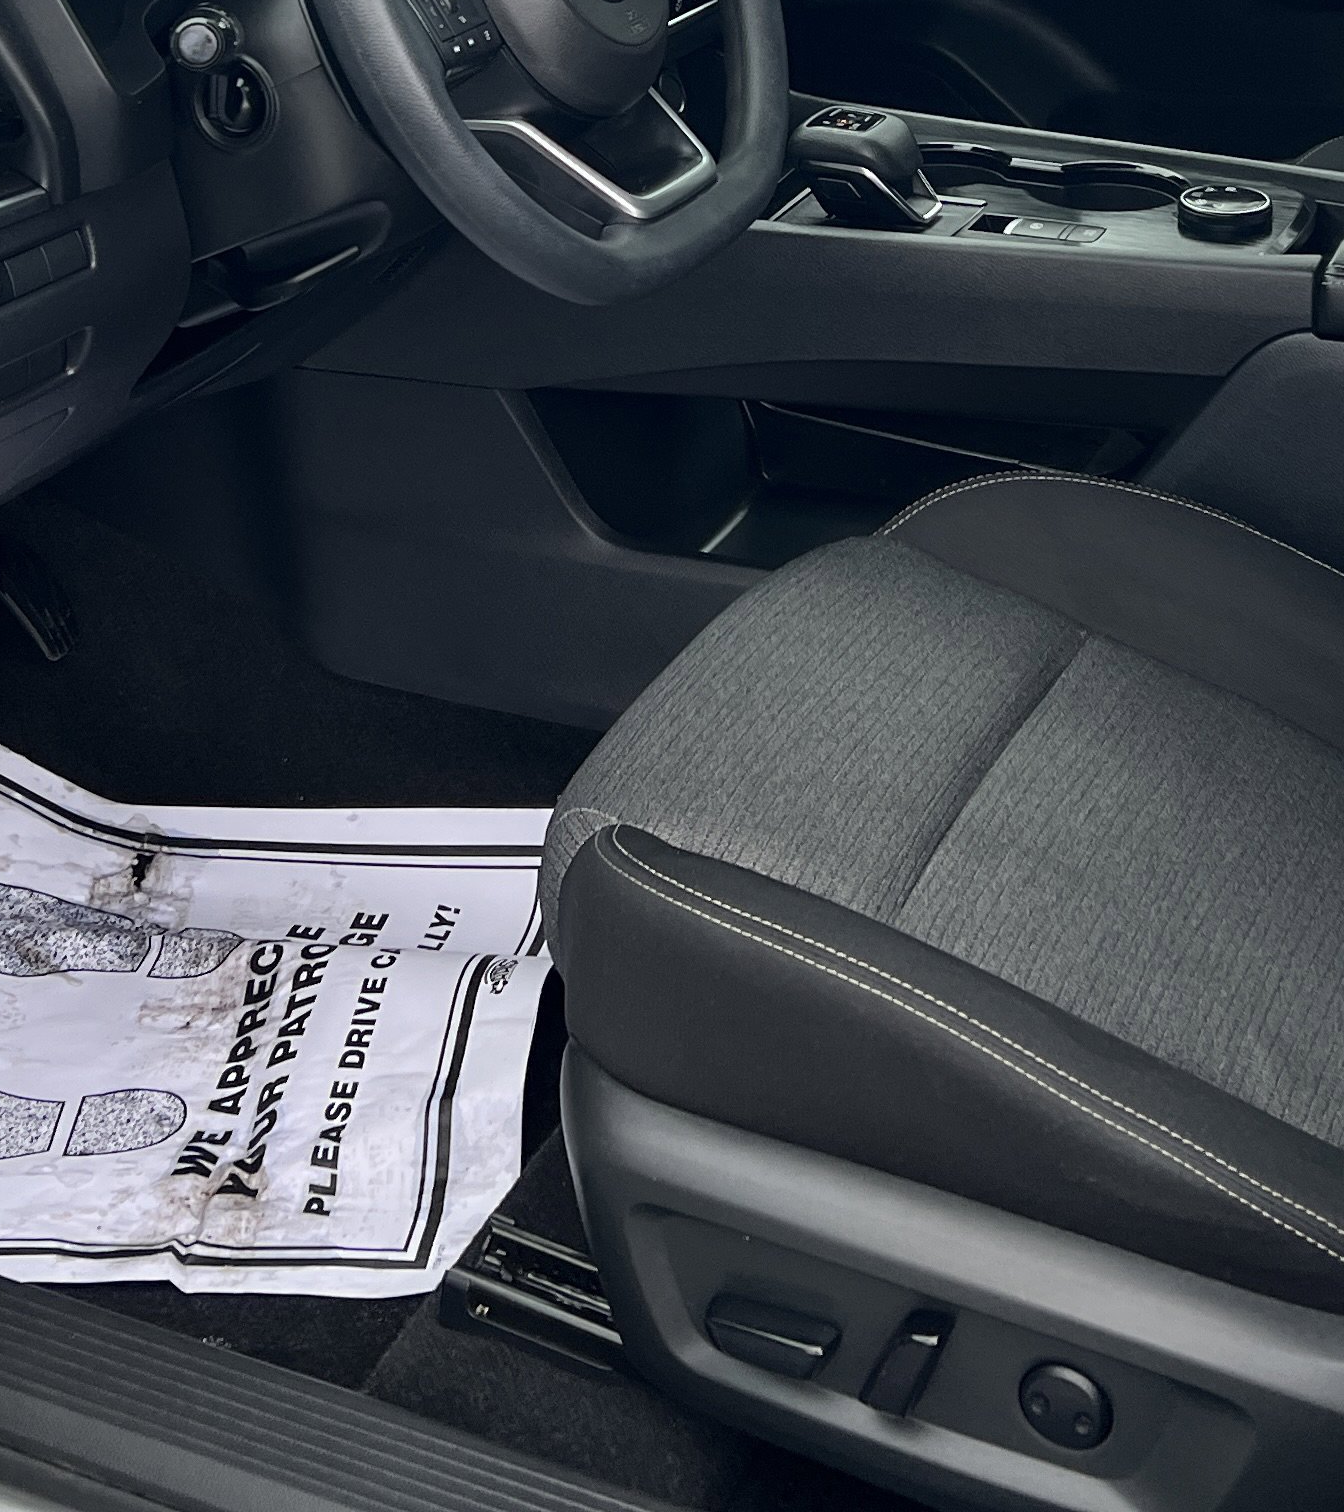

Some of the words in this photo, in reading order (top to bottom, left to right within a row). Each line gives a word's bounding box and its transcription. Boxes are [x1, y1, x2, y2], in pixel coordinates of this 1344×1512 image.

[170, 1129, 234, 1179] WE
[214, 1074, 291, 1198] YOUR
[303, 1080, 360, 1217] PLEASE
[338, 977, 389, 1070] DRIVE
